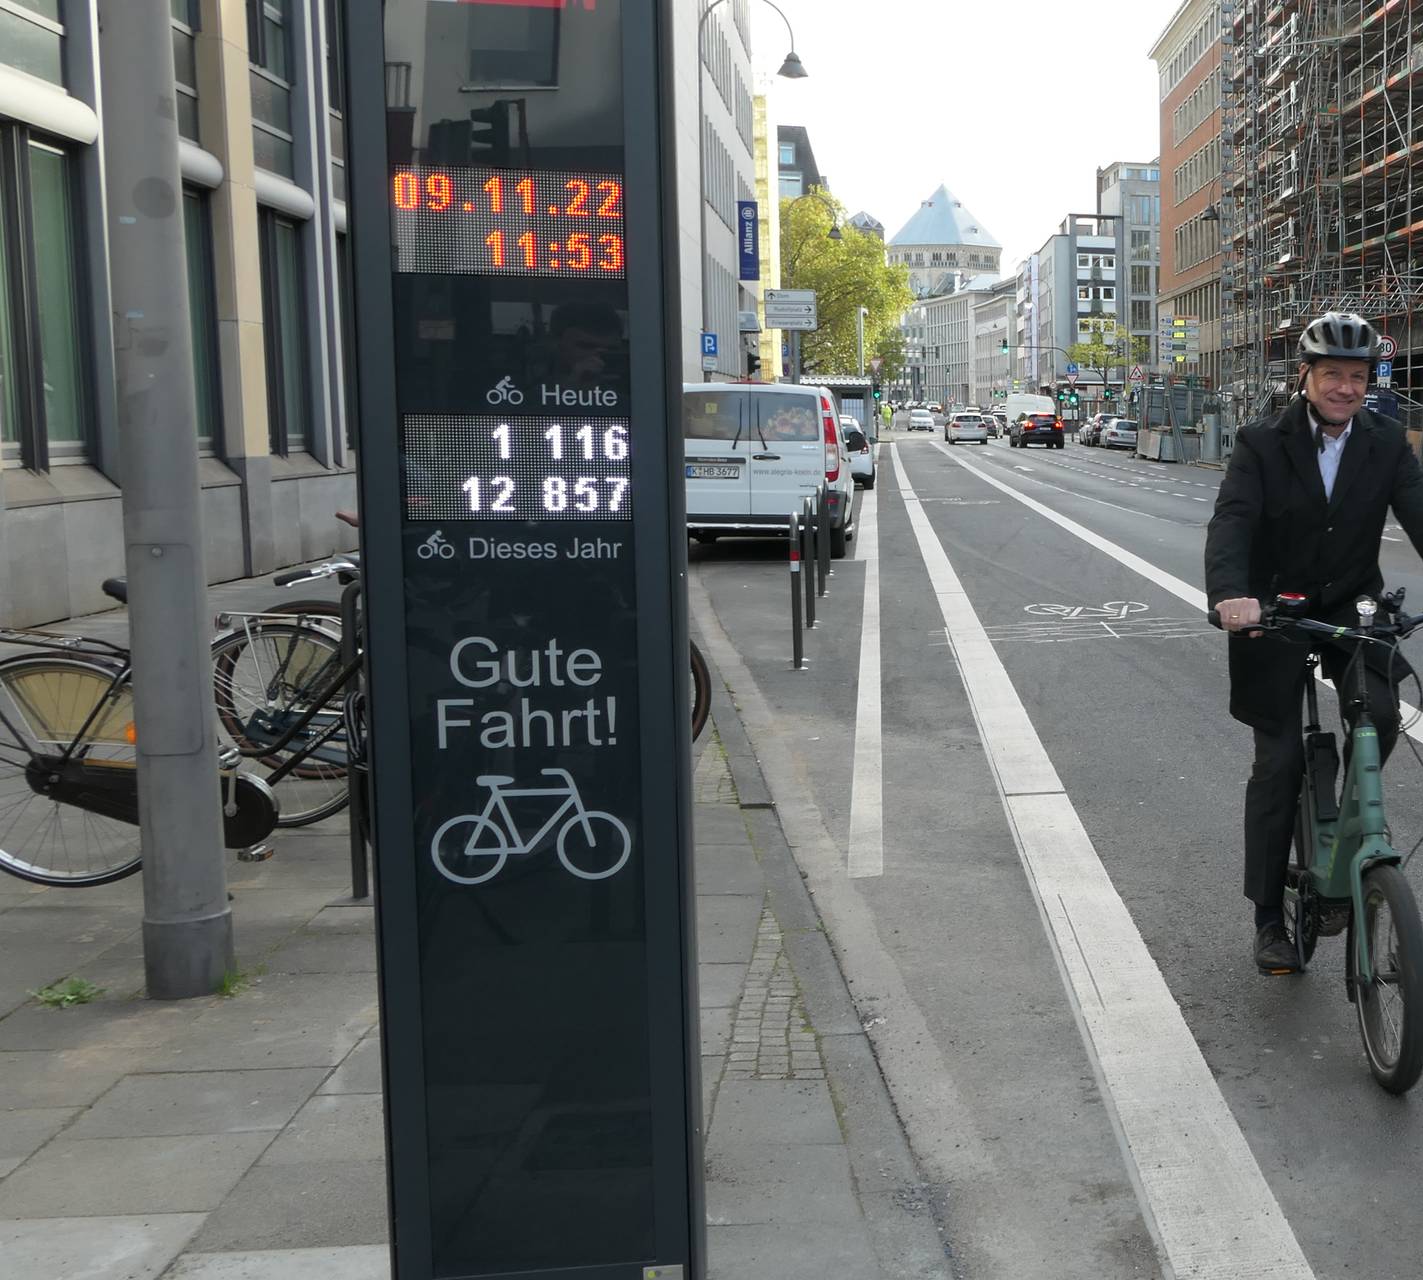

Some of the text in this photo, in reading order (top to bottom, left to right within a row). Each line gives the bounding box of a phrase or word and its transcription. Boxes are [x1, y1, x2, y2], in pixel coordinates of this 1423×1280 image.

[394, 172, 623, 217] 09.11.22
[485, 229, 624, 270] 11:53
[744, 221, 754, 255] Allianz
[541, 384, 618, 406] Heute
[492, 424, 629, 460] 1 116
[703, 467, 715, 476] HB
[716, 467, 738, 476] 3677
[463, 476, 629, 511] 12 857
[469, 537, 622, 560] Dieses Jahr
[450, 636, 603, 688] Gute
[437, 696, 617, 749] Fahrt!
